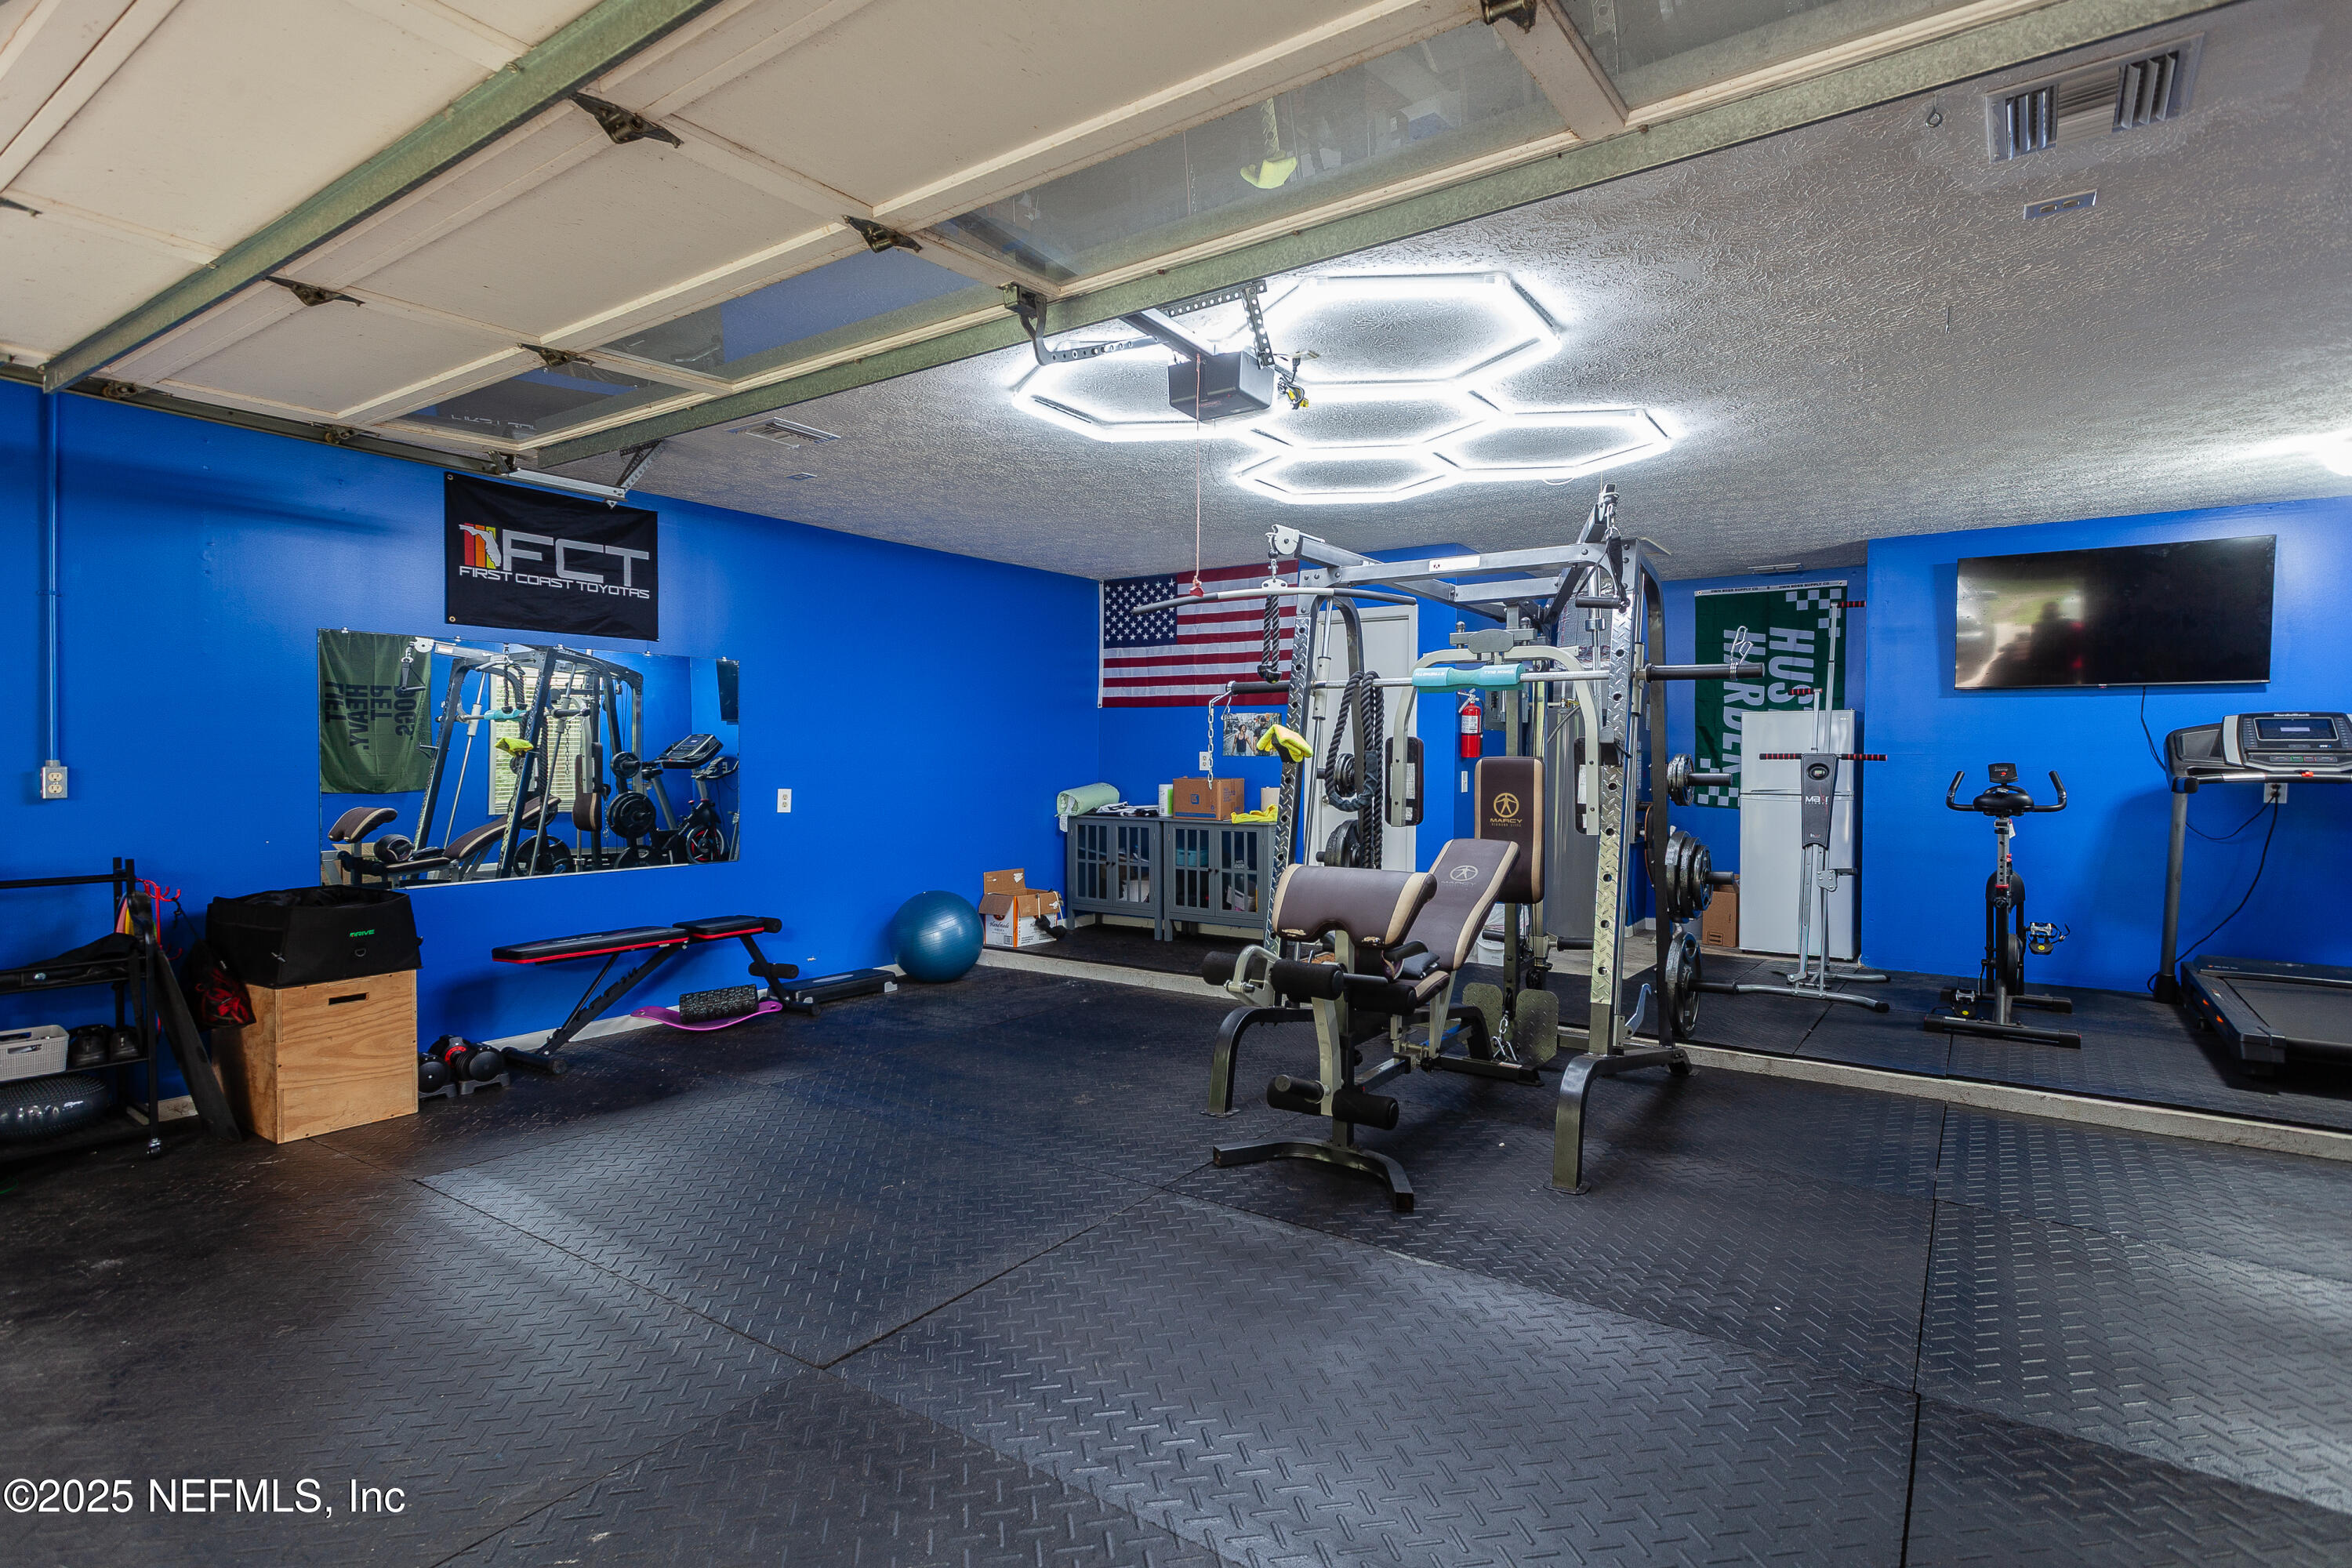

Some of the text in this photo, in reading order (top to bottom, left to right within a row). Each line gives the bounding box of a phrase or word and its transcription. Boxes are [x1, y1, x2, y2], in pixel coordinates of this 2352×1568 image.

[459, 565, 650, 600] FIRST COAST TOYOTAS
[503, 528, 650, 588] FCT
[1767, 626, 1815, 711] HUS
